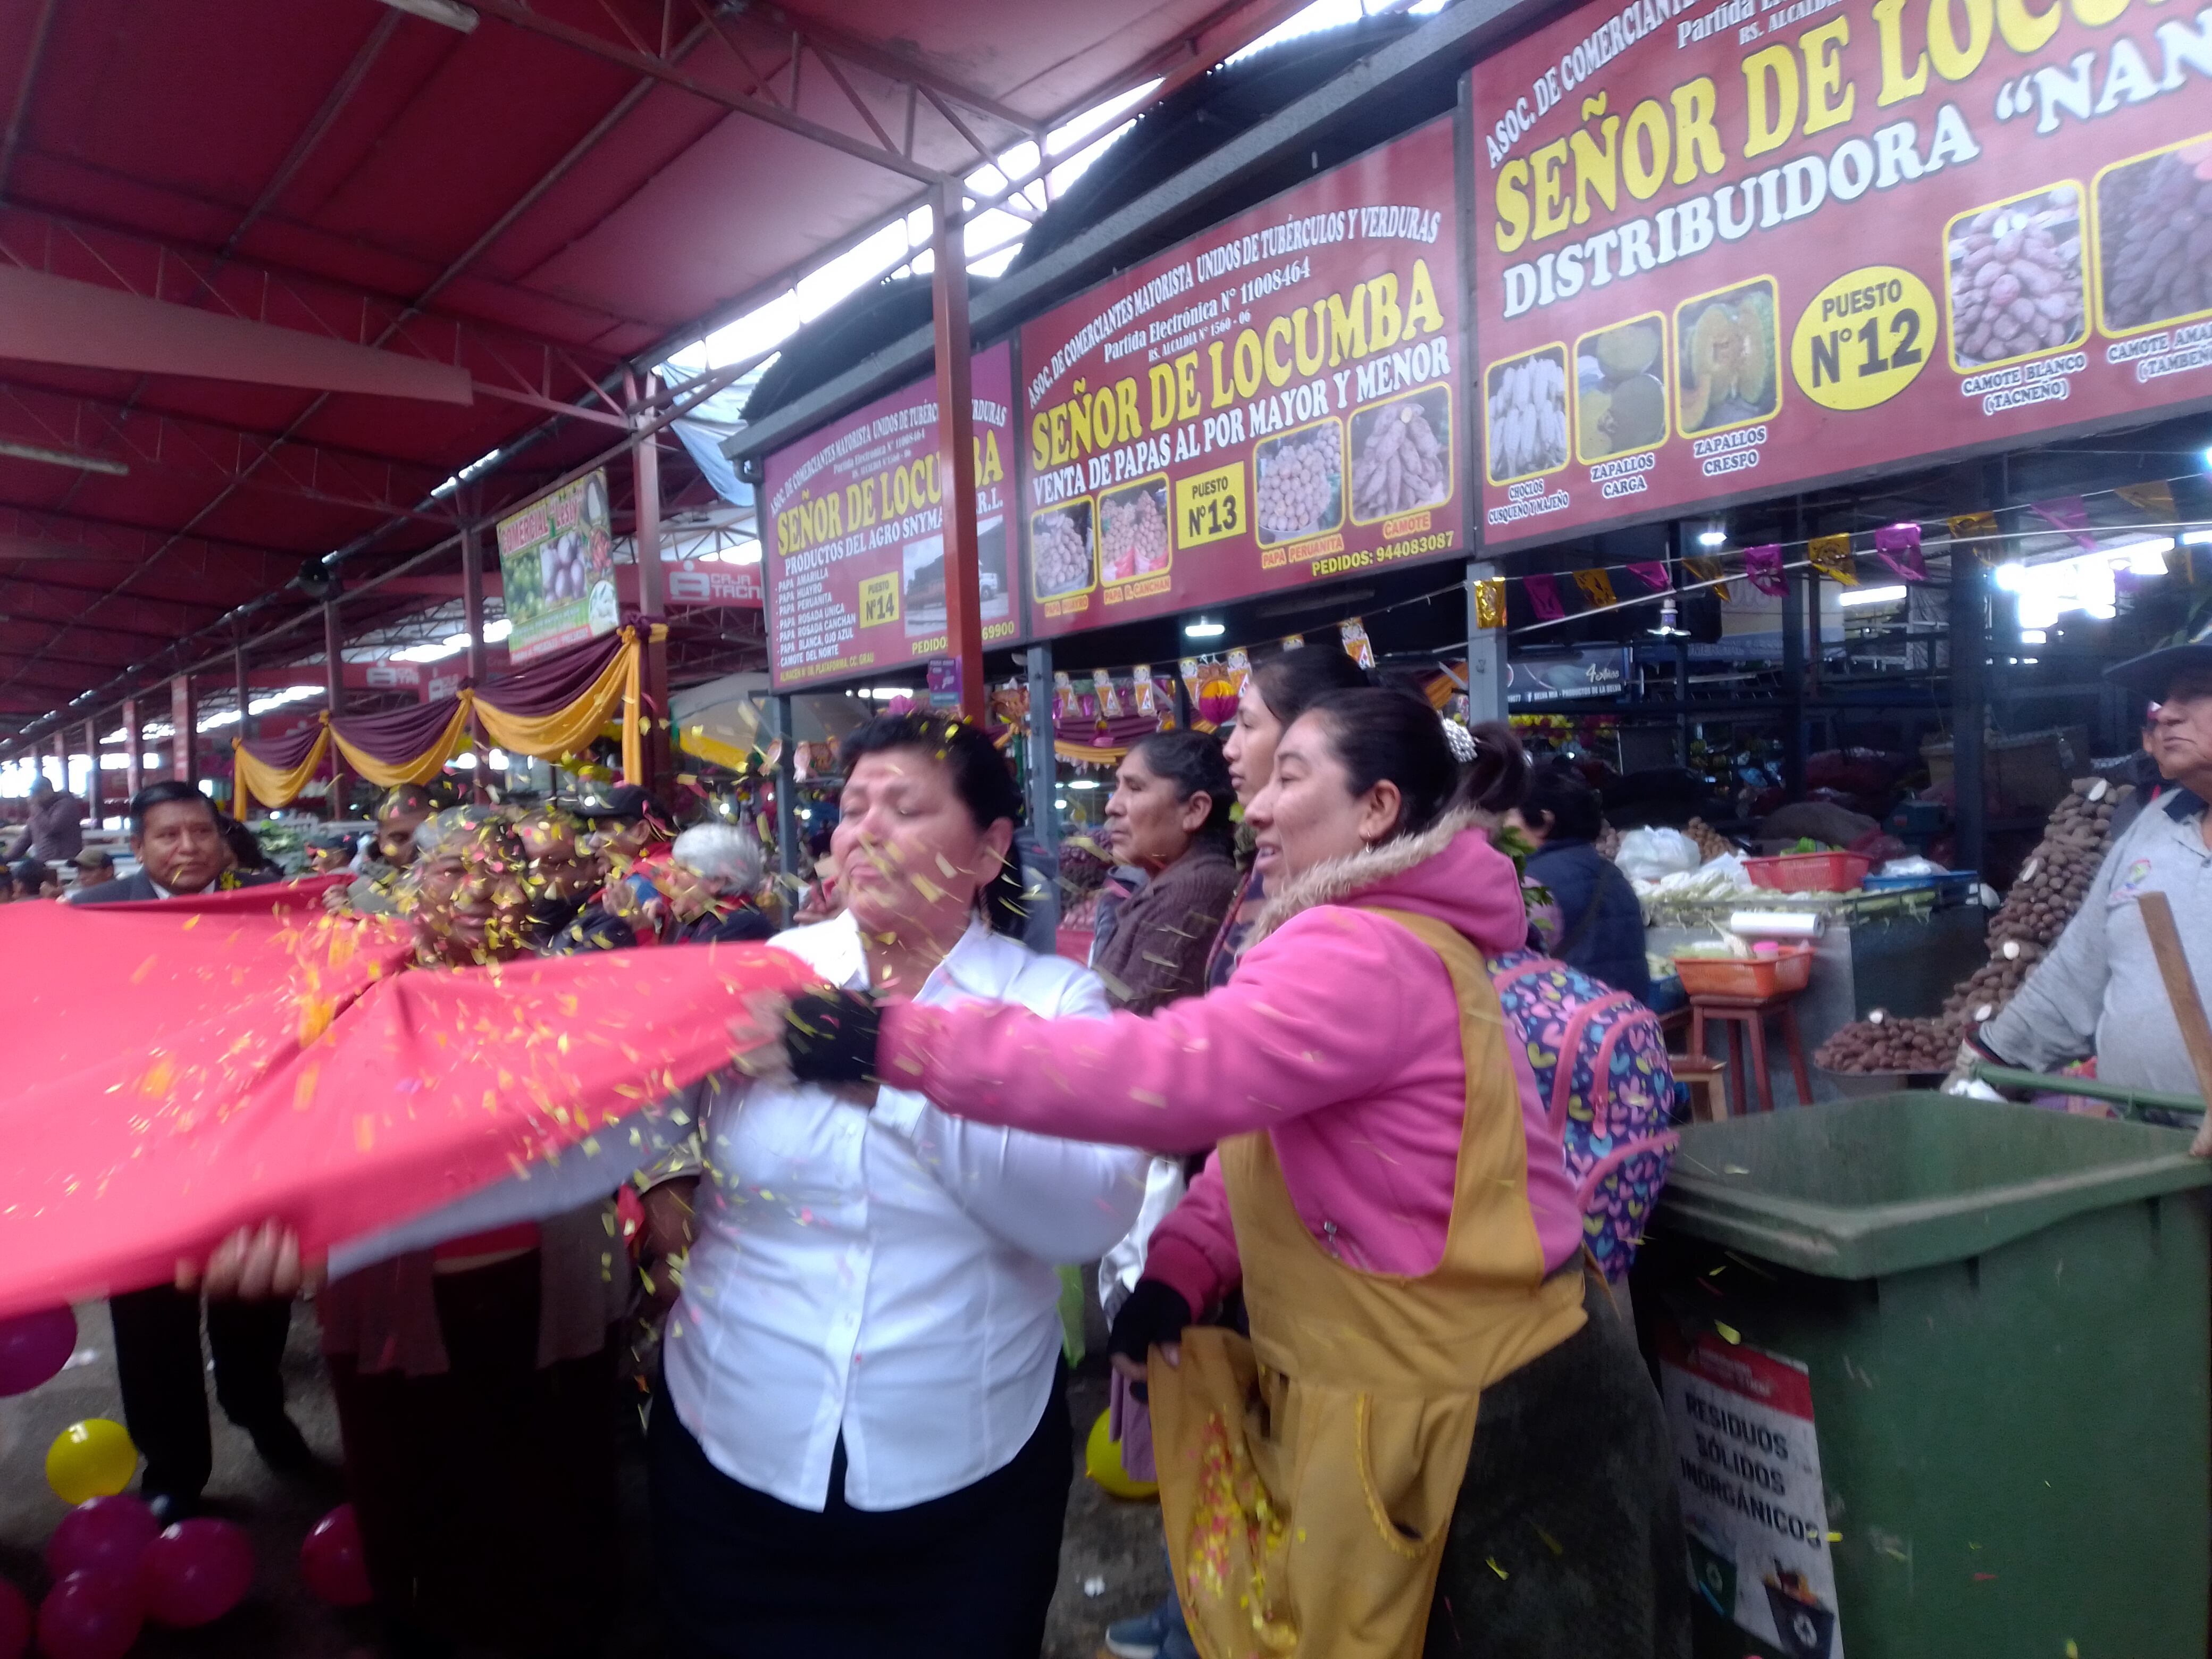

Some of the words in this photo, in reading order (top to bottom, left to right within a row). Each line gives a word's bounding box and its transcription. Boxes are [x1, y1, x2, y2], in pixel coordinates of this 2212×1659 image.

[1677, 0, 1756, 49] Partida
[1486, 97, 1536, 169] ASOC.
[1533, 66, 1562, 117] DE
[1495, 77, 1725, 253] SEÑOR
[1740, 14, 1855, 158] DE
[1503, 104, 1980, 319] DISTRIBUIDORA
[1028, 365, 1053, 409] ASOC.
[1051, 348, 1066, 380] DE
[1063, 295, 1135, 368] COMERCIANTES
[1133, 261, 1195, 317] MAYORISTA
[1196, 240, 1241, 283] UNIDOS
[1242, 232, 1260, 265] DE
[1260, 214, 1346, 259] TUBÉRCULOS
[1347, 208, 1359, 239] Y
[1360, 205, 1442, 245] VERDURAS
[1103, 329, 1148, 363] Partida
[1149, 299, 1218, 343] Electrónica
[1220, 287, 1237, 311] N°
[1239, 256, 1311, 305] 11008464
[1822, 278, 1903, 323] PUESTO
[1858, 308, 1922, 378] 12
[2107, 331, 2170, 365] CAMOTE
[1031, 376, 1143, 472] SEÑOR
[1148, 349, 1202, 432] DE
[1208, 258, 1444, 409] LOCUMBA
[1961, 366, 2021, 397] CAMOTE
[2024, 351, 2088, 382] BLANCO
[1982, 376, 2071, 416] (TACNEÑO)
[872, 413, 899, 440] UNIDOS
[899, 409, 909, 430] DE
[909, 398, 939, 427] TUBÉRC
[971, 398, 1008, 428] RDURAS
[1033, 463, 1086, 506] VENTA
[1088, 454, 1112, 491] DE
[1114, 433, 1170, 482] PAPAS
[1174, 423, 1201, 464] AL
[1203, 407, 1245, 454] POR
[1248, 378, 1329, 438] MAYOR
[1333, 371, 1350, 409] Y
[1355, 336, 1451, 403] MENOR
[1694, 426, 1767, 459] ZAPALLOS
[1590, 452, 1655, 482] ZAPALLOS
[1703, 449, 1760, 476] CRESPO
[1192, 475, 1229, 500] PUESTO
[1509, 478, 1544, 501] CHOCLOS
[1602, 475, 1647, 500] CARGA
[777, 488, 843, 557] SEÑOR
[845, 476, 876, 532] DE
[1208, 495, 1238, 535] 13
[1488, 500, 1529, 525] CUSQUEÑO
[1529, 500, 1537, 516] Y
[1536, 489, 1570, 515] MAJEÑO
[1382, 510, 1431, 540] CAMOTE
[785, 540, 844, 577] PRODUCTOS
[845, 532, 867, 558] DEL
[868, 520, 901, 550] AGRO
[1261, 547, 1287, 570] PAPA
[1311, 549, 1373, 577] PEDIDOS:
[1376, 530, 1455, 563] 944083087
[710, 572, 751, 586] CAJA
[710, 584, 763, 600] TACN
[778, 577, 794, 593] PAPA
[797, 567, 829, 586] AMARILLA
[778, 590, 794, 605] PAPA
[797, 582, 823, 598] HUAYRO
[867, 580, 890, 596] PUESTO
[779, 603, 795, 617] PAPA
[797, 591, 833, 611] PERUANITA
[780, 616, 795, 631] PAPA
[798, 610, 824, 626] ROSADA
[877, 592, 895, 620] 14
[780, 629, 795, 643] PAPA
[798, 623, 824, 639] ROSADA
[824, 612, 857, 631] CANCHAN
[780, 642, 795, 656] PAPA
[824, 631, 837, 644] OJO
[837, 626, 854, 642] AZUL
[780, 652, 804, 668] CAMOTE
[805, 649, 818, 663] DEL
[818, 643, 839, 660] NORTE
[911, 635, 949, 656] PEDIDO
[1685, 1391, 1789, 1461] RESIDUOS
